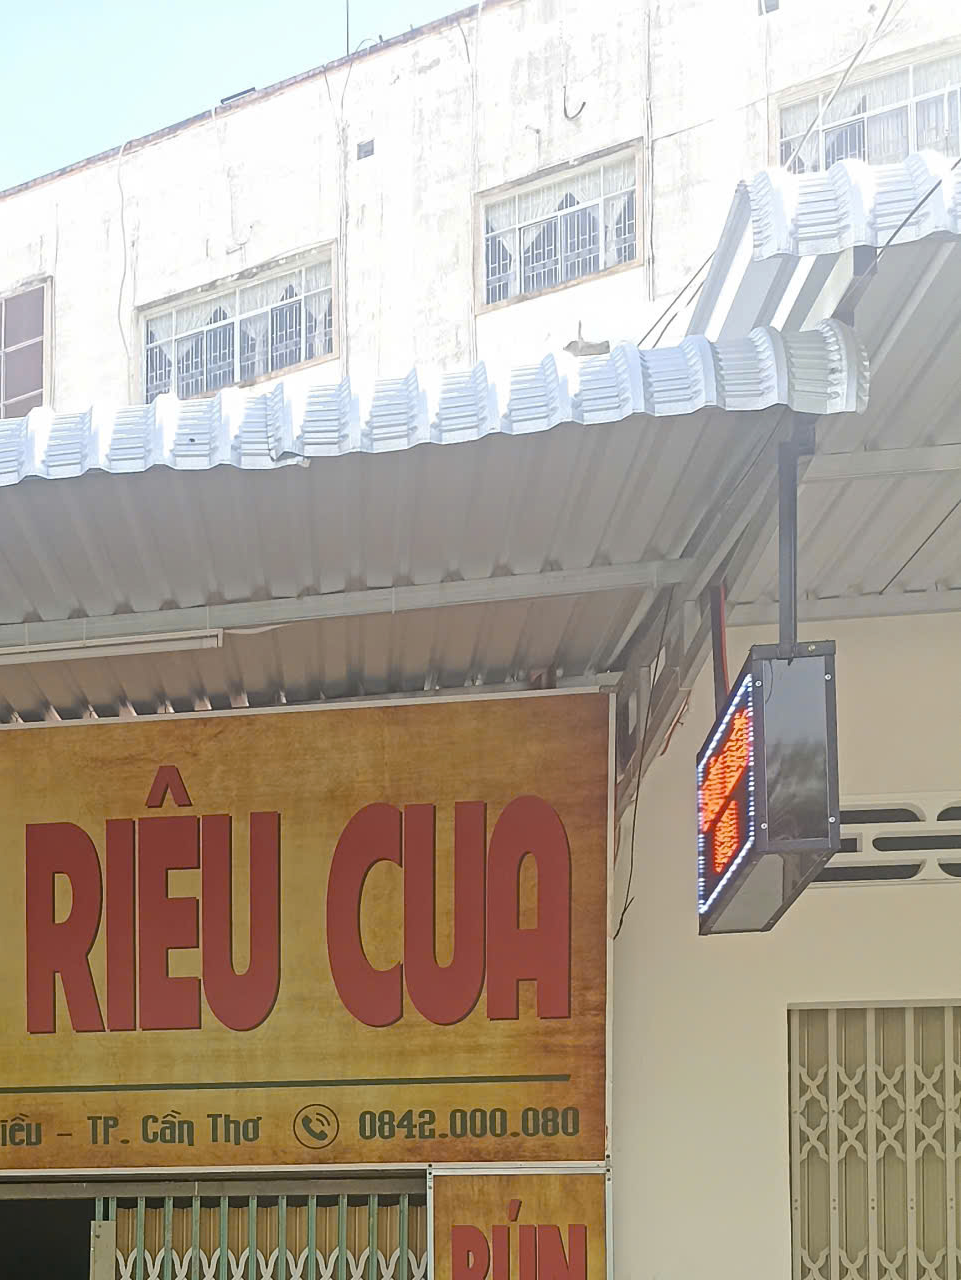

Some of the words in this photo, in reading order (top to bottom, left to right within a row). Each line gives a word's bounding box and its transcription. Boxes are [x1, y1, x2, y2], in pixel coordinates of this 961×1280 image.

[25, 765, 282, 1034] RIÊU
[326, 795, 572, 1028] CUA
[86, 1115, 130, 1145] TP.
[142, 1109, 195, 1147] Cần
[206, 1113, 263, 1146] Thơ
[358, 1106, 580, 1140] 0842.000.080
